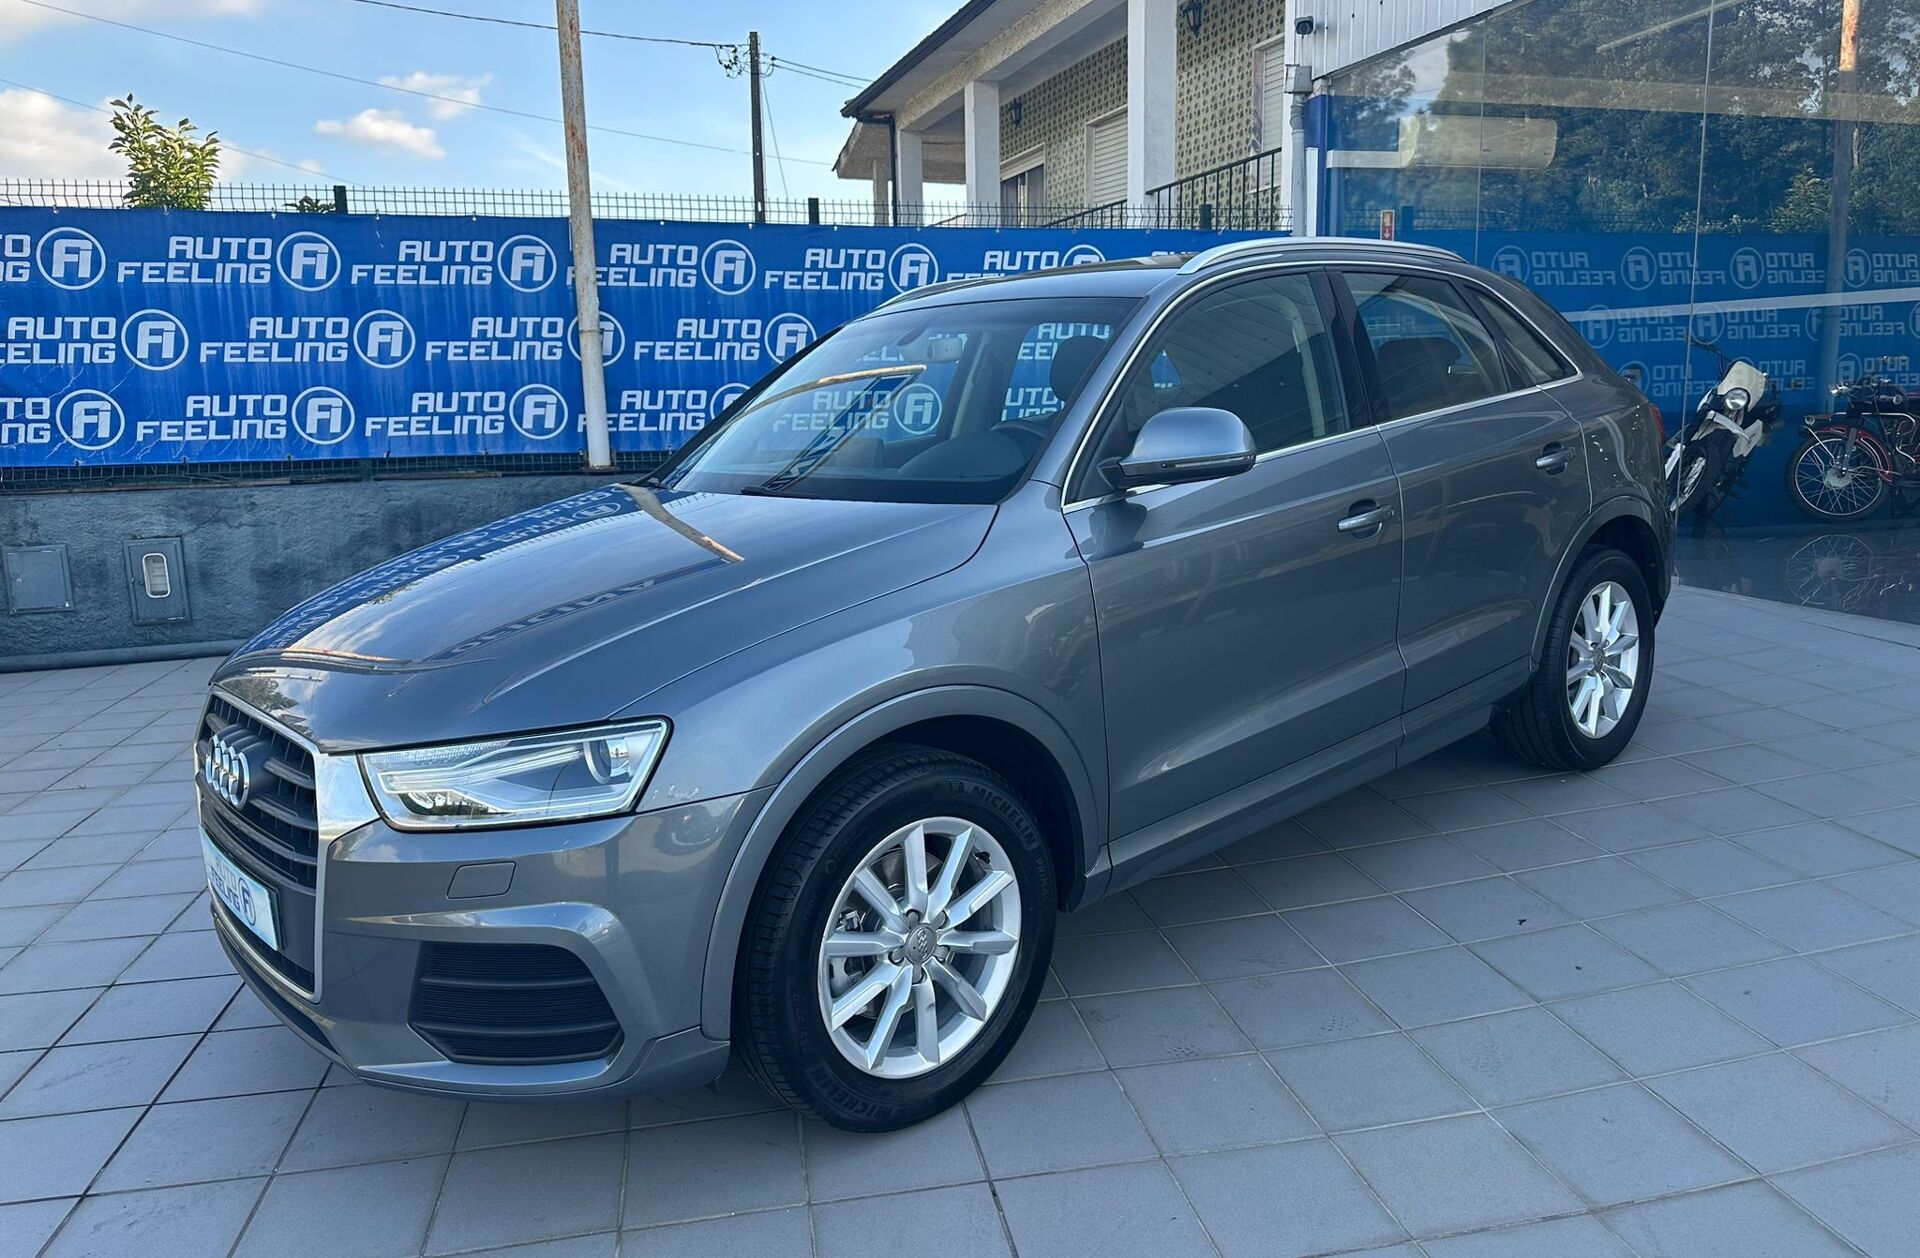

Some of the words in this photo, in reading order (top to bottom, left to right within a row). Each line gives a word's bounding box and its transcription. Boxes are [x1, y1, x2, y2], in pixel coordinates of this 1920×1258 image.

[169, 237, 272, 259] AUTO
[399, 241, 493, 261] AUTO
[611, 244, 697, 265] AUTO
[805, 249, 885, 269] AUTO
[982, 249, 1061, 271] AUTO
[118, 263, 270, 283] FEELING
[352, 265, 492, 284] FEELING
[765, 271, 883, 290] FEELING
[8, 317, 116, 339] AUTO
[250, 318, 349, 338] AUTO
[472, 318, 563, 337] AUTO
[677, 319, 761, 338] AUTO
[200, 342, 348, 362] FEELING
[426, 342, 562, 360] FEELING
[635, 342, 759, 360] FEELING
[187, 395, 287, 417] AUTO
[412, 392, 505, 412] AUTO
[621, 390, 706, 409] AUTO
[812, 388, 891, 411] AUTO
[137, 420, 286, 441] FEELING
[366, 415, 504, 436] FEELING
